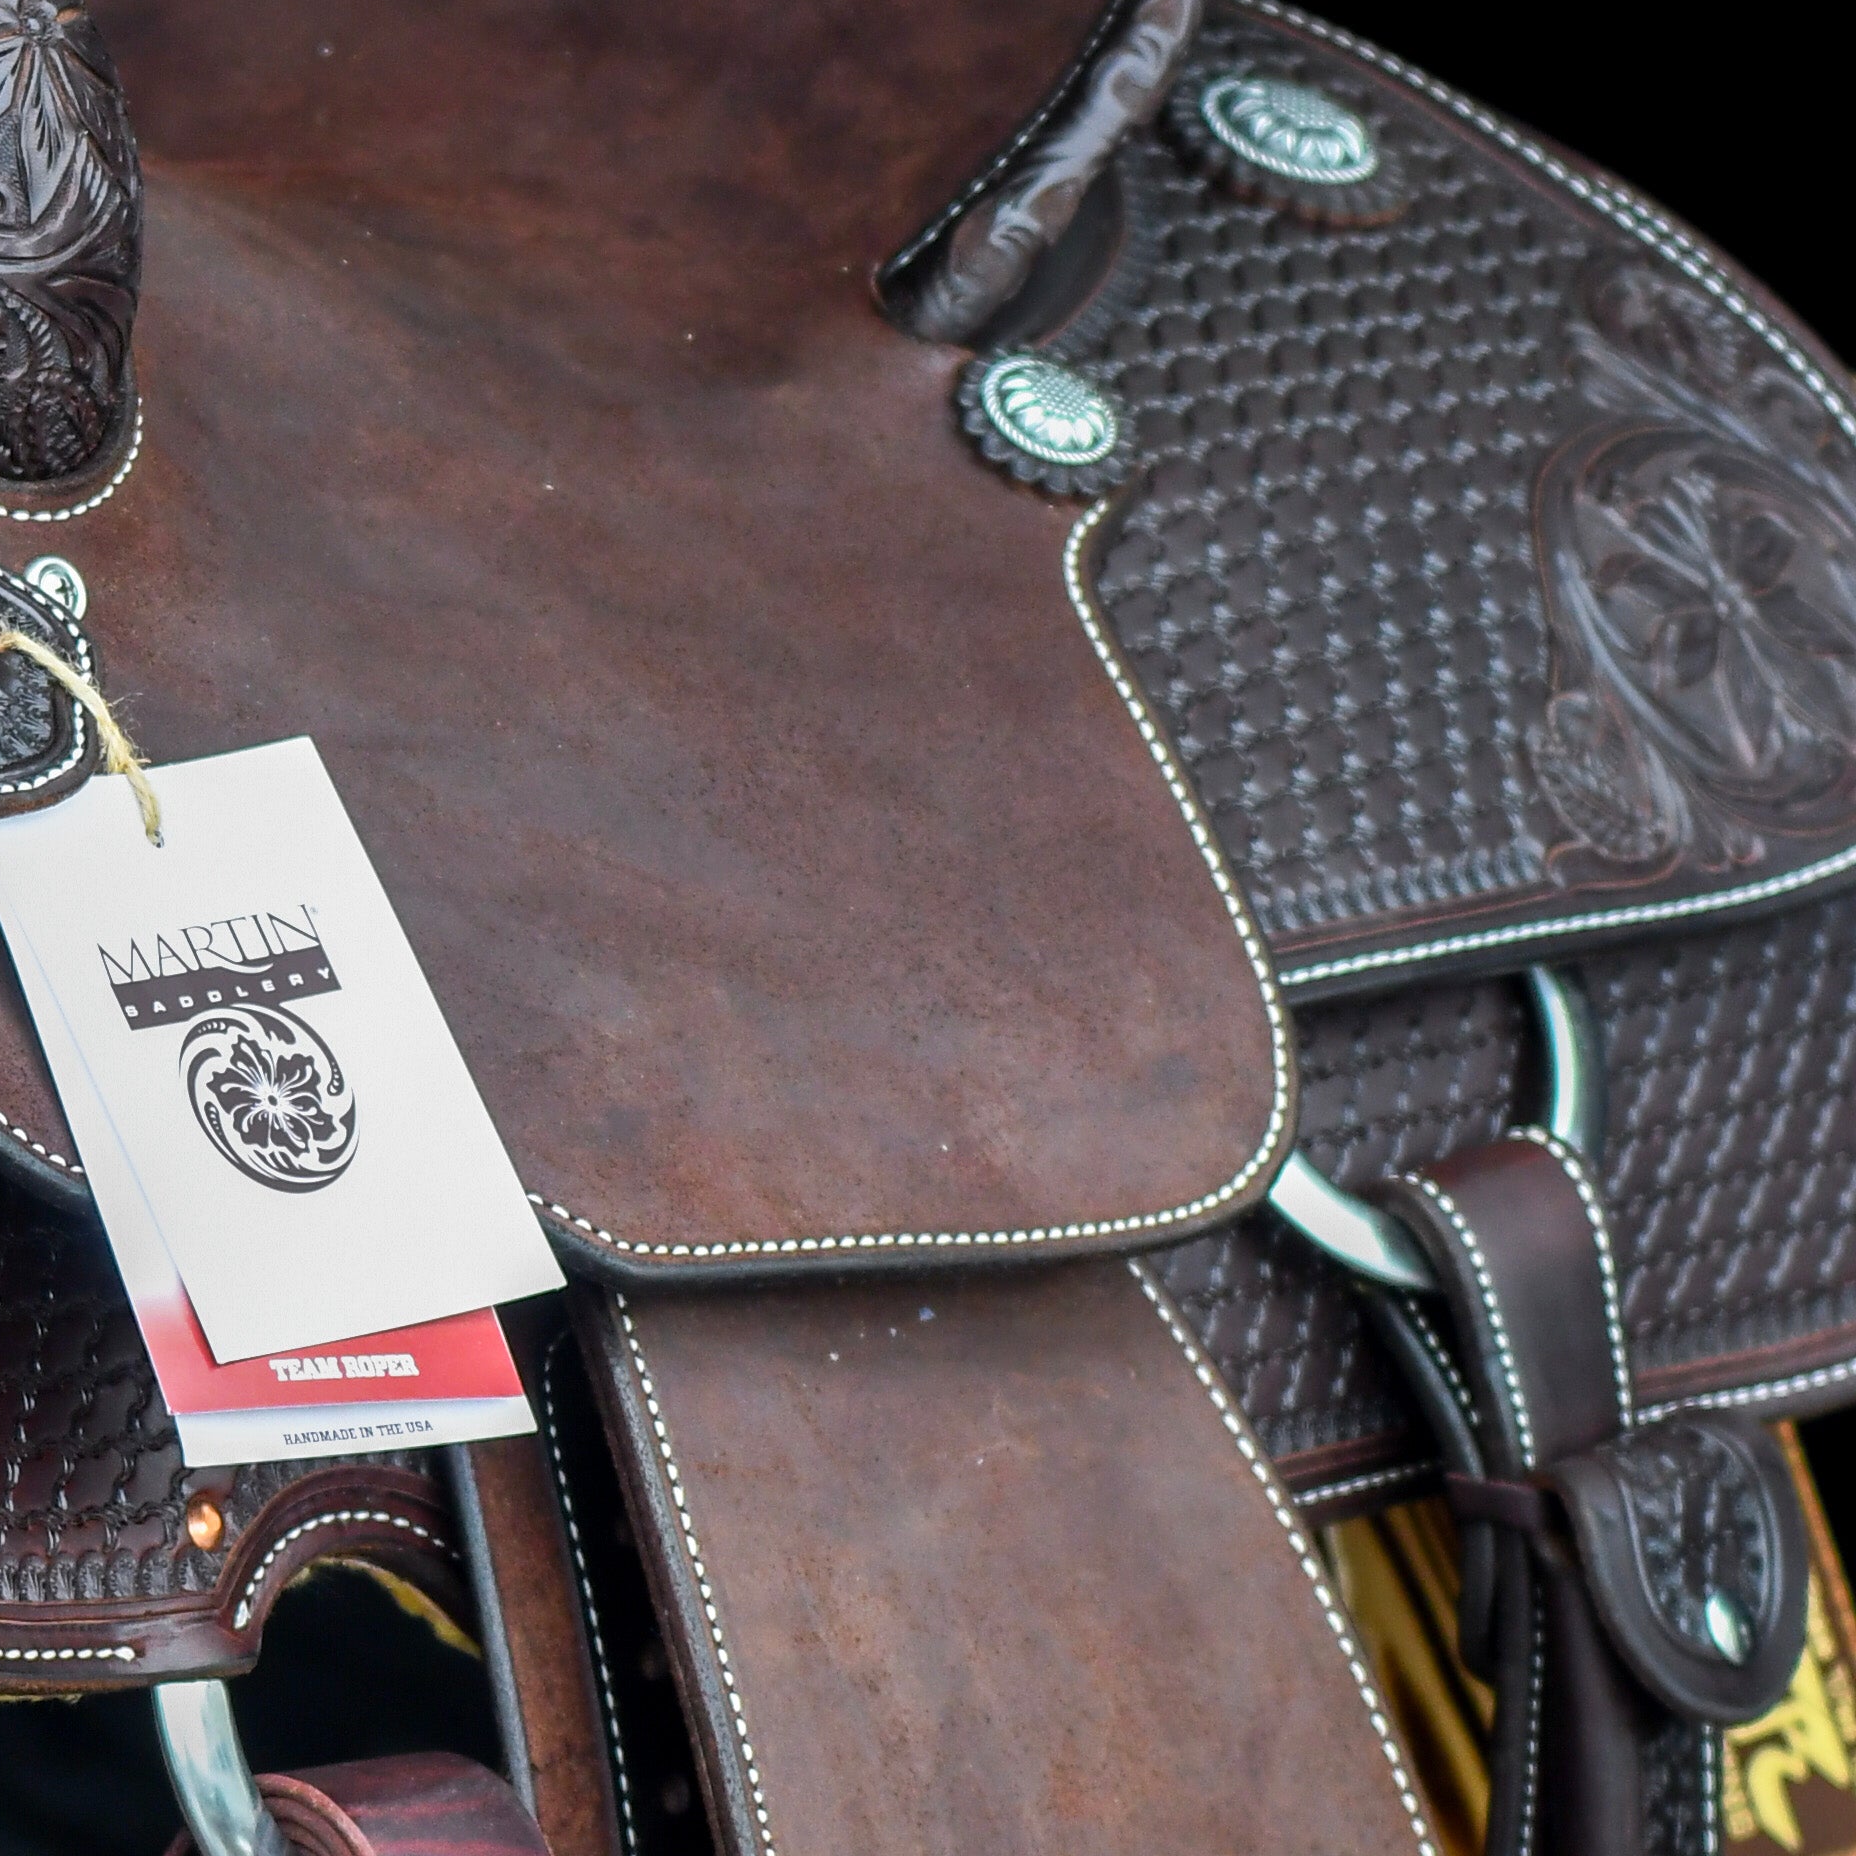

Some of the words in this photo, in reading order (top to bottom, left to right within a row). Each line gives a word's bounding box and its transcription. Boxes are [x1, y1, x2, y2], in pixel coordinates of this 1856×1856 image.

[96, 904, 320, 985] MARTIN
[123, 967, 331, 1018] SADDLERY
[269, 1357, 343, 1381] TEAM
[341, 1353, 420, 1378] ROPER
[283, 1427, 358, 1445] HANDMADE
[359, 1426, 374, 1439] IN
[376, 1423, 404, 1437] THE
[405, 1419, 434, 1434] USA
